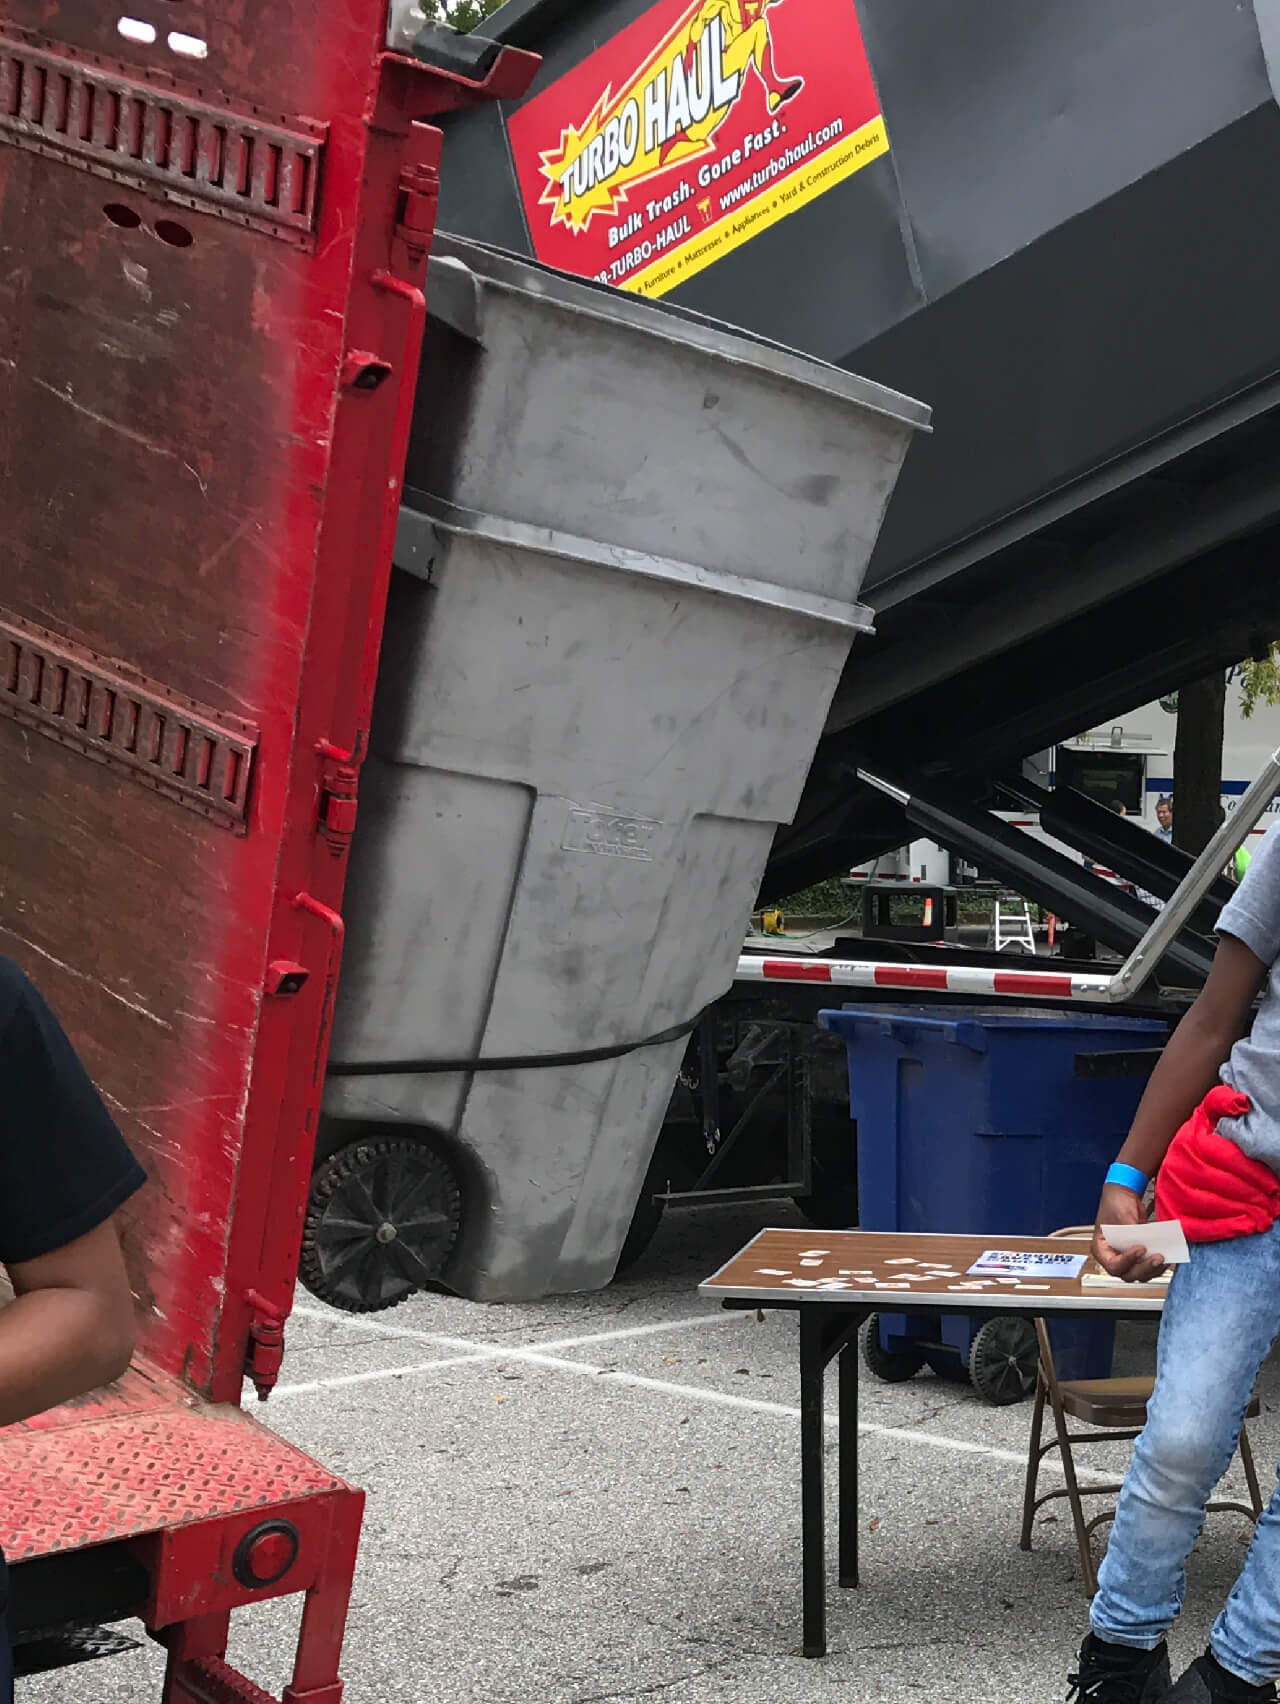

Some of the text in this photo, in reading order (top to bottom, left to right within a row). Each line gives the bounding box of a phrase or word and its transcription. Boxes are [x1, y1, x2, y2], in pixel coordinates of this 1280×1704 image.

[560, 14, 741, 206] TURBO HAUL
[719, 118, 844, 211] www.turbohaul.com
[608, 119, 788, 248] Bulk Trash. Gone Fast.
[644, 265, 675, 290] Furniture
[732, 206, 771, 235] Appliances
[779, 186, 798, 204] Yard
[806, 150, 854, 187] Construction
[854, 133, 880, 155] Debris
